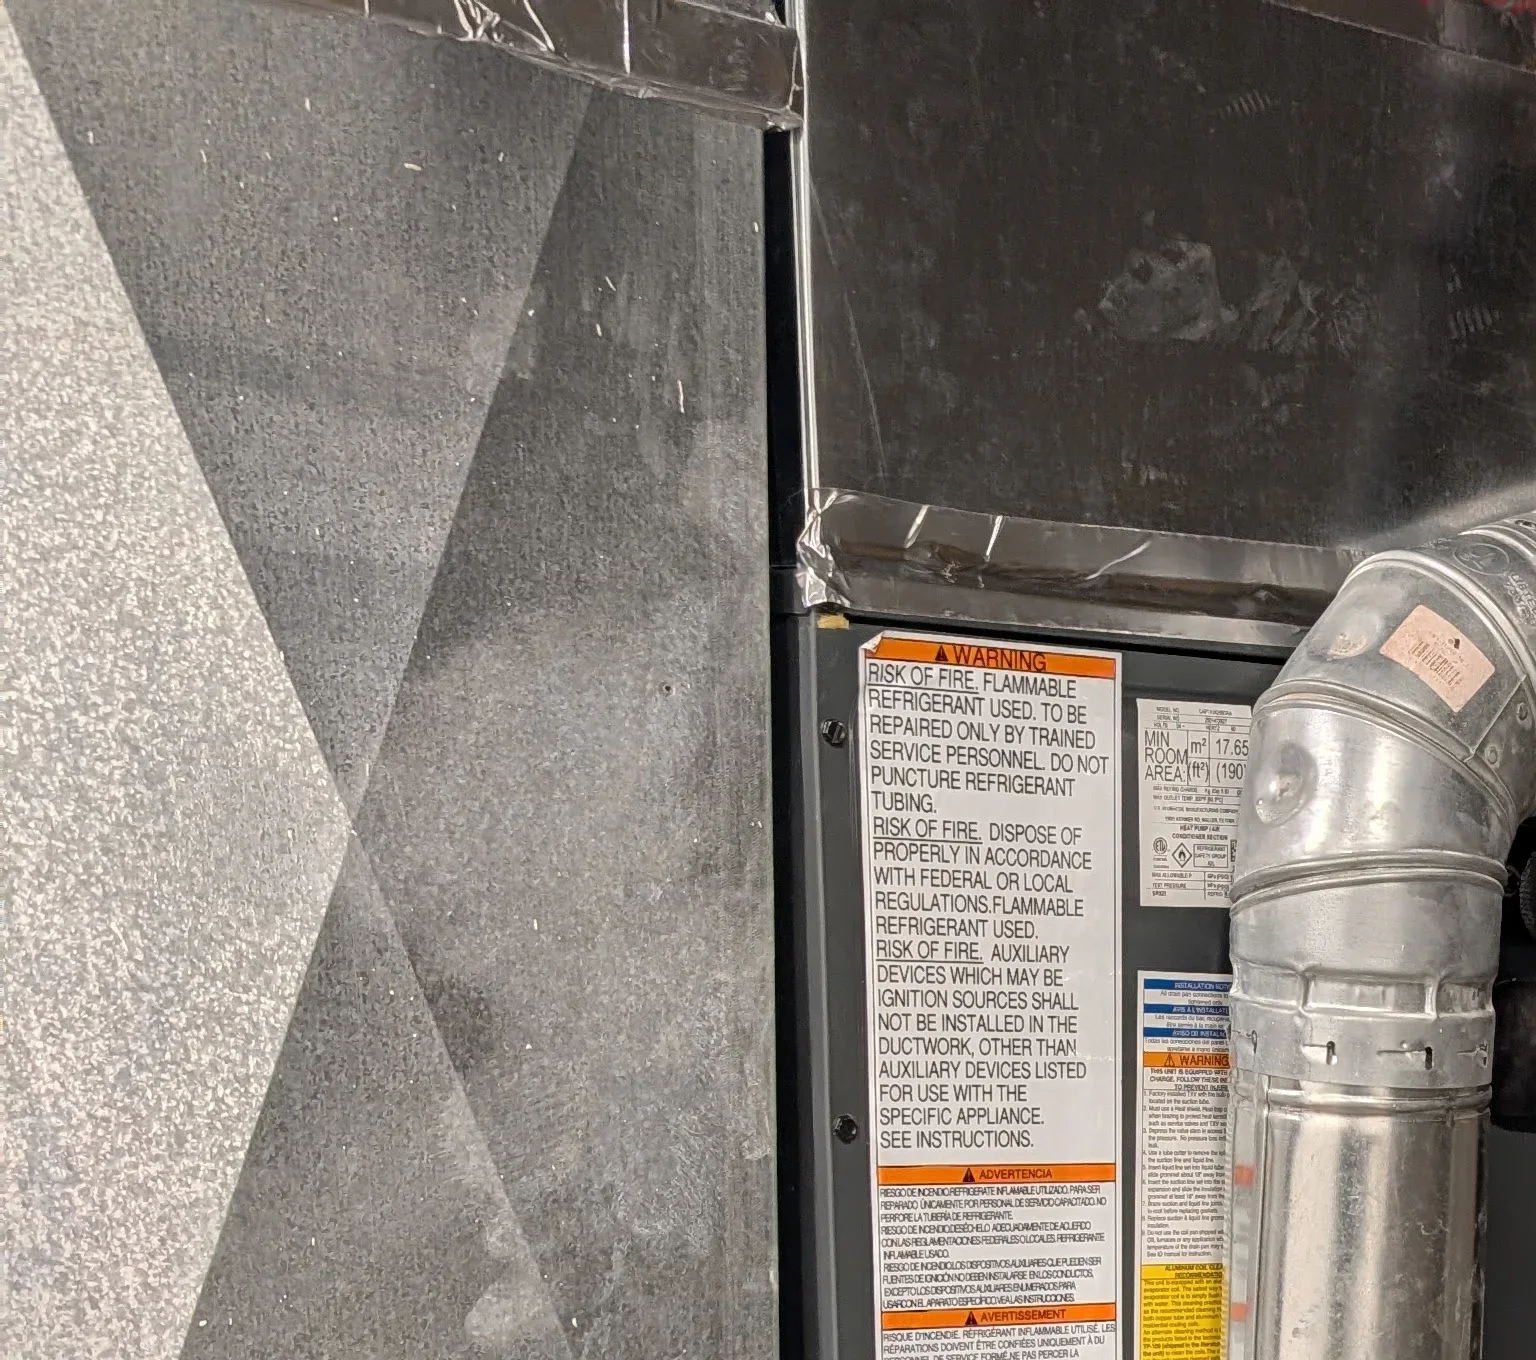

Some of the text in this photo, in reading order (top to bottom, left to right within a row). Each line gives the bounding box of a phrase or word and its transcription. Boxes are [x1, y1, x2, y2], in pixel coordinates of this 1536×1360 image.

[953, 646, 1047, 671] WARNING
[868, 663, 1076, 698] RISK OF FIRE. FLAMMABLE
[868, 689, 1087, 724] REFRIGERANT USED. TO BE
[870, 714, 1095, 749] REPAIRED ONLY BY TRAINED
[1145, 730, 1169, 747] MIN
[870, 740, 1109, 774] SERVICE PERSONNEL. DO NOT
[1145, 747, 1188, 765] ROOM
[1216, 739, 1249, 756] 17.65
[871, 766, 1075, 796] PUNCTURE REFRIGERANT
[1145, 765, 1185, 782] AREA:
[871, 791, 937, 813] TUBING.
[874, 816, 1082, 845] RISK OF FIRE. DISPOSE OF
[874, 842, 1091, 869] PROPERLY IN ACCORDANCE
[874, 867, 1073, 893] WITH FEDERAL OR LOCAL
[876, 916, 1038, 939] REFRIGERANT USED.
[877, 940, 1069, 963] RISK OF FIRE. AUXILIARY
[877, 965, 1063, 986] DEVICES WHICH MAY BE
[878, 989, 1079, 1010] IGNITION SOURCES SHALL
[878, 1013, 1077, 1033] NOT BE INSTALLED IN THE
[879, 1037, 1076, 1058] DUCTWORK, OTHER THAN
[879, 1061, 1086, 1079] AUXILIARY DEVICES LISTED
[1180, 1055, 1229, 1066] WARNING
[880, 1085, 1027, 1102] FOR USE WITH THE
[880, 1108, 1044, 1125] SPECIFIC APPLIANCE.
[880, 1130, 1034, 1148] SEE INSTRUCTIONS.
[979, 1168, 1052, 1179] ADVERTENCIA
[981, 1309, 1066, 1322] AVERTISSEMENT
